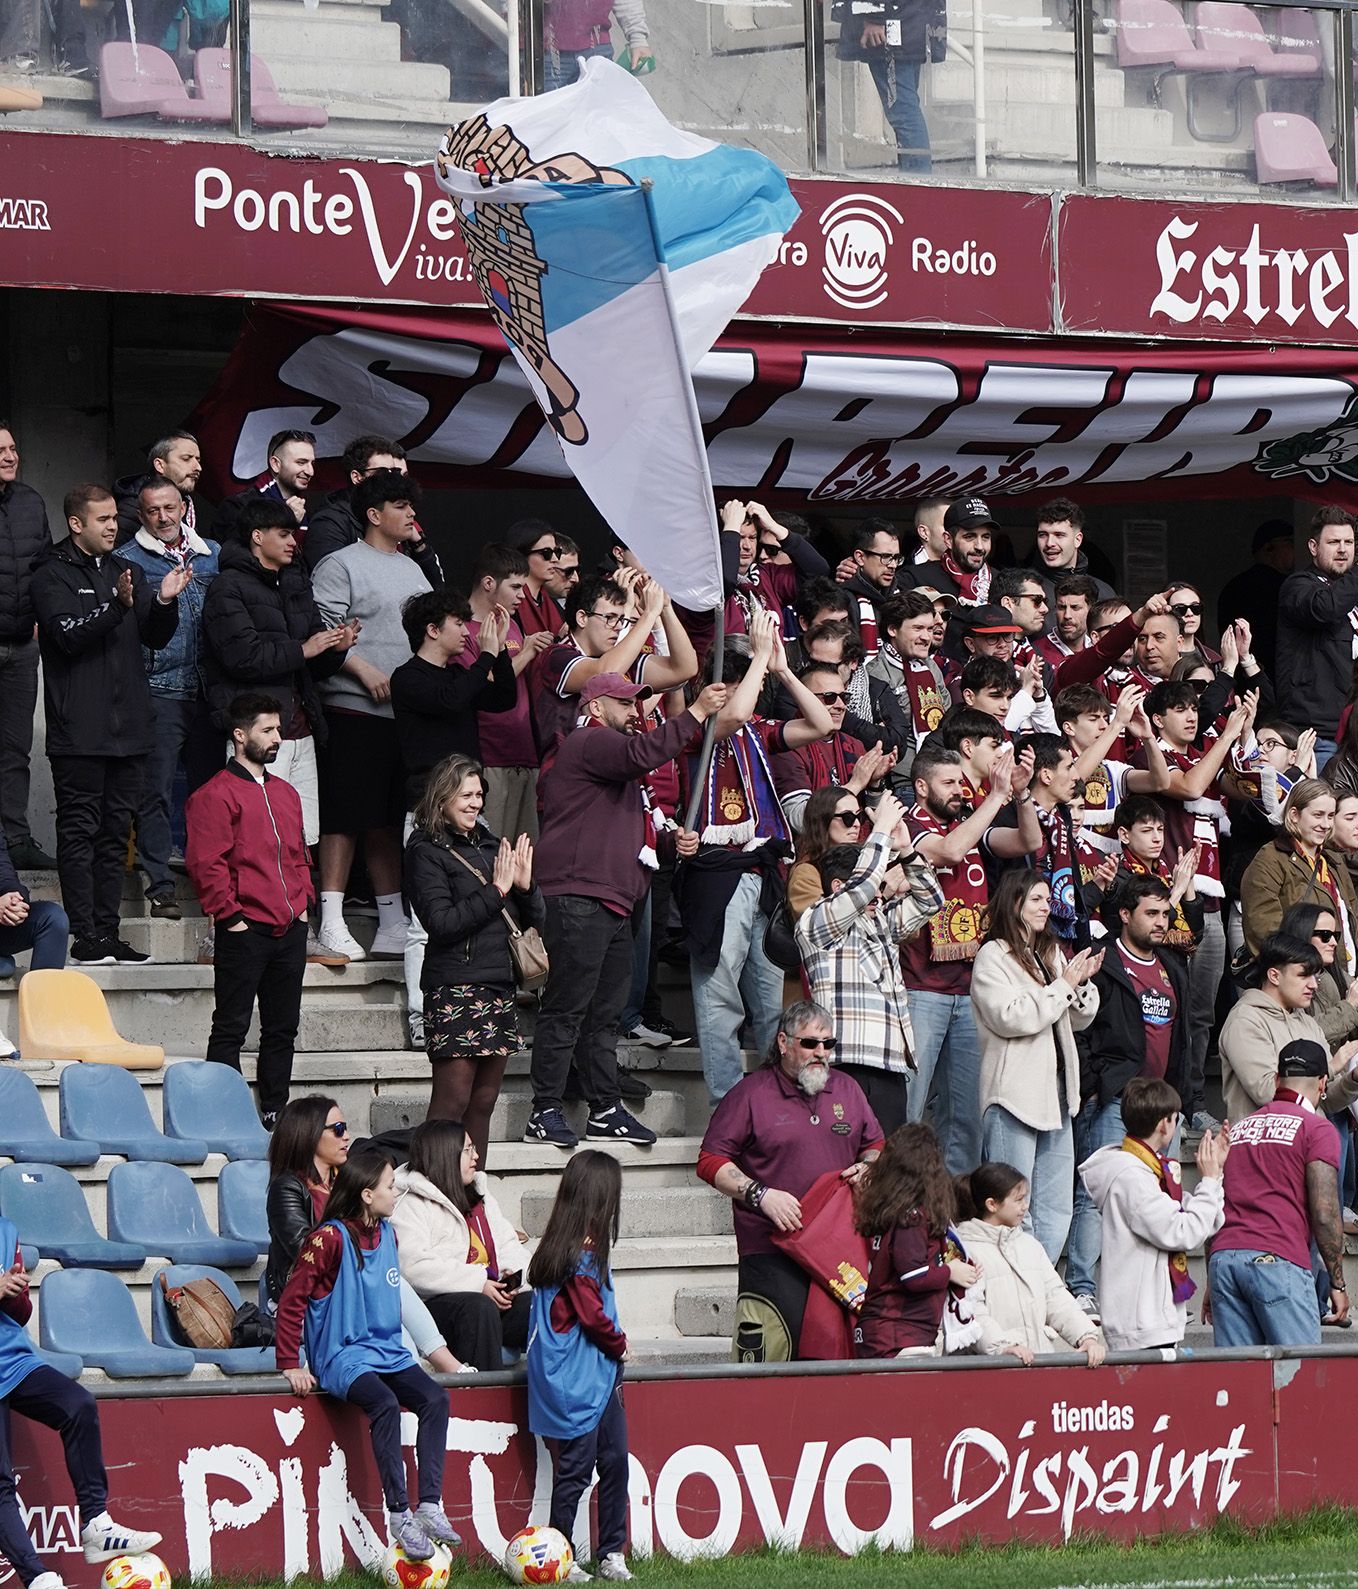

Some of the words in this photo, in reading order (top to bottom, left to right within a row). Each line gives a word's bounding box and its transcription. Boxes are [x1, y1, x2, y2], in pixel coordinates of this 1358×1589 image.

[195, 166, 456, 286] PonteVe
[829, 232, 884, 270] Viva
[912, 236, 998, 277] Radio
[1142, 994, 1171, 1008] Estrella
[1142, 1004, 1169, 1016] Galicia
[1052, 1400, 1134, 1432] tiendas
[929, 1414, 1254, 1545] Dispaint
